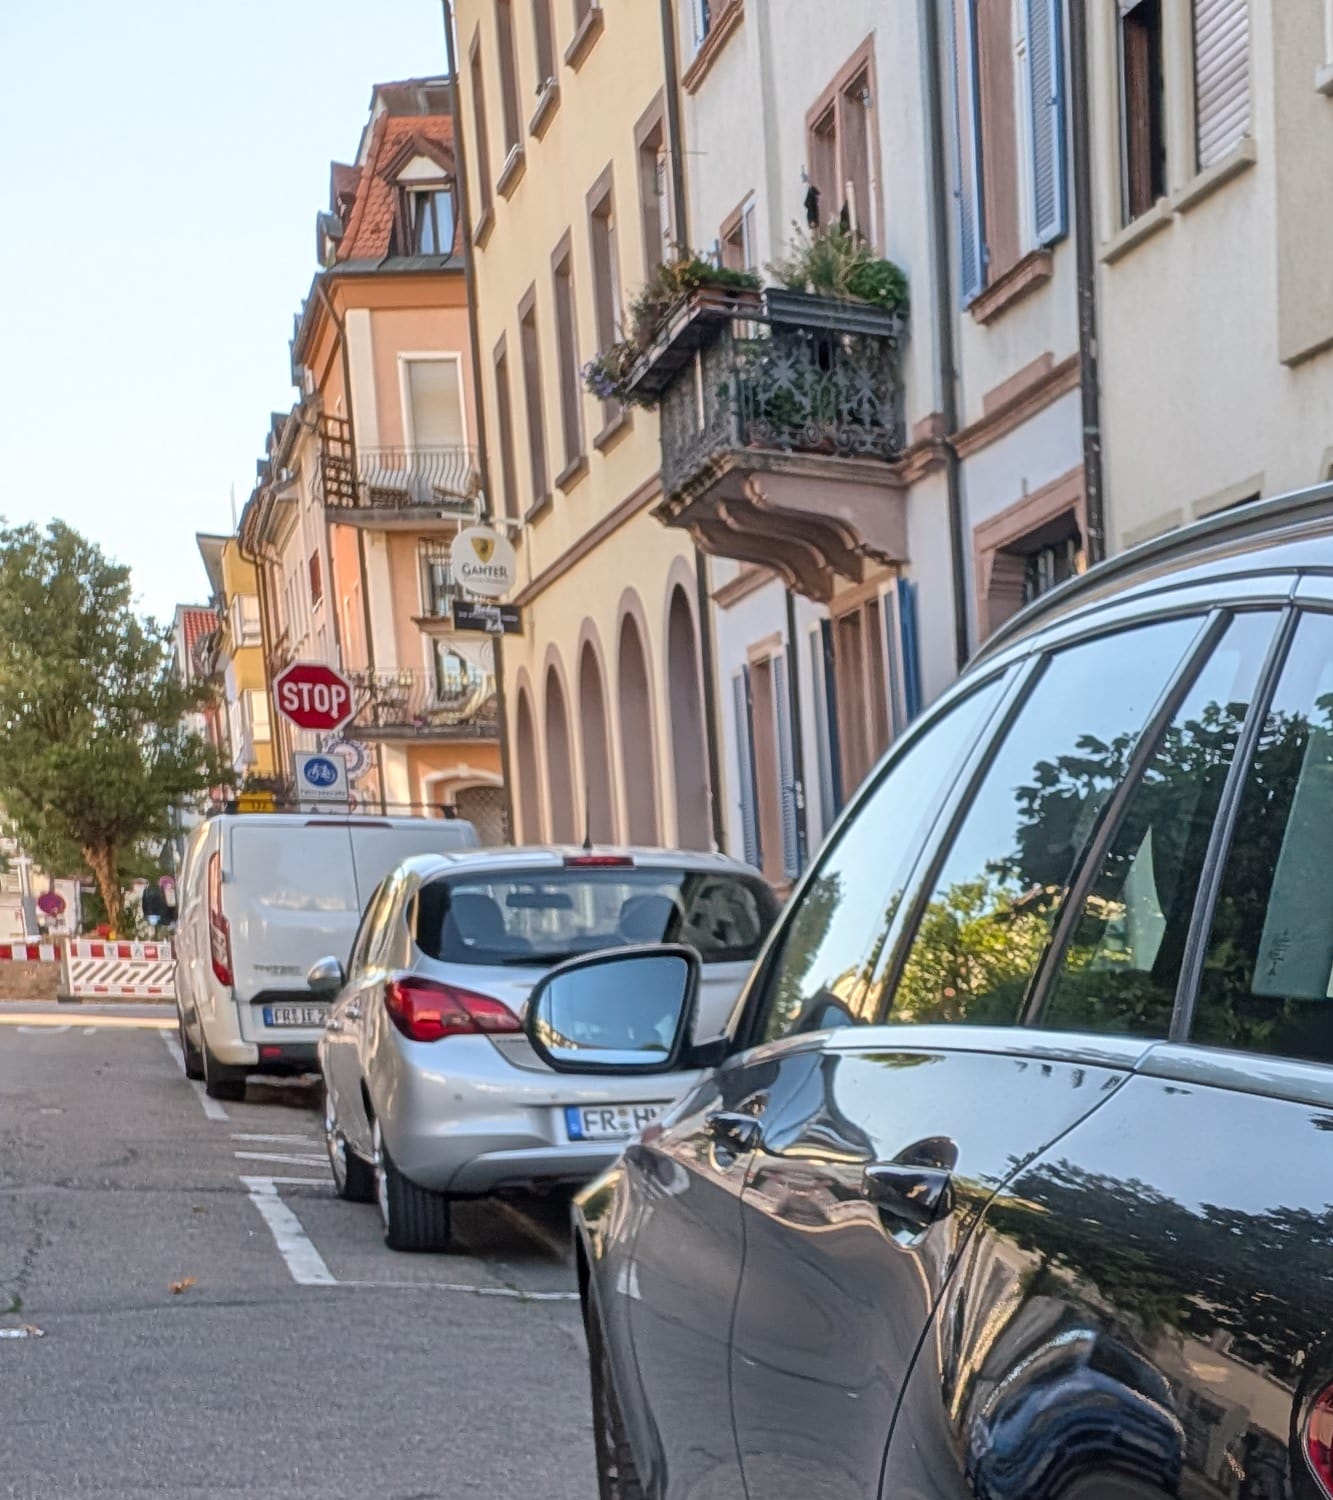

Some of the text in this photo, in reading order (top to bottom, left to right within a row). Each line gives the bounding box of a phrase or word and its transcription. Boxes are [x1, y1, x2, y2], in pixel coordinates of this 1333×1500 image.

[461, 561, 508, 578] GANTER
[282, 681, 347, 719] STOP
[583, 1109, 617, 1132] FR
